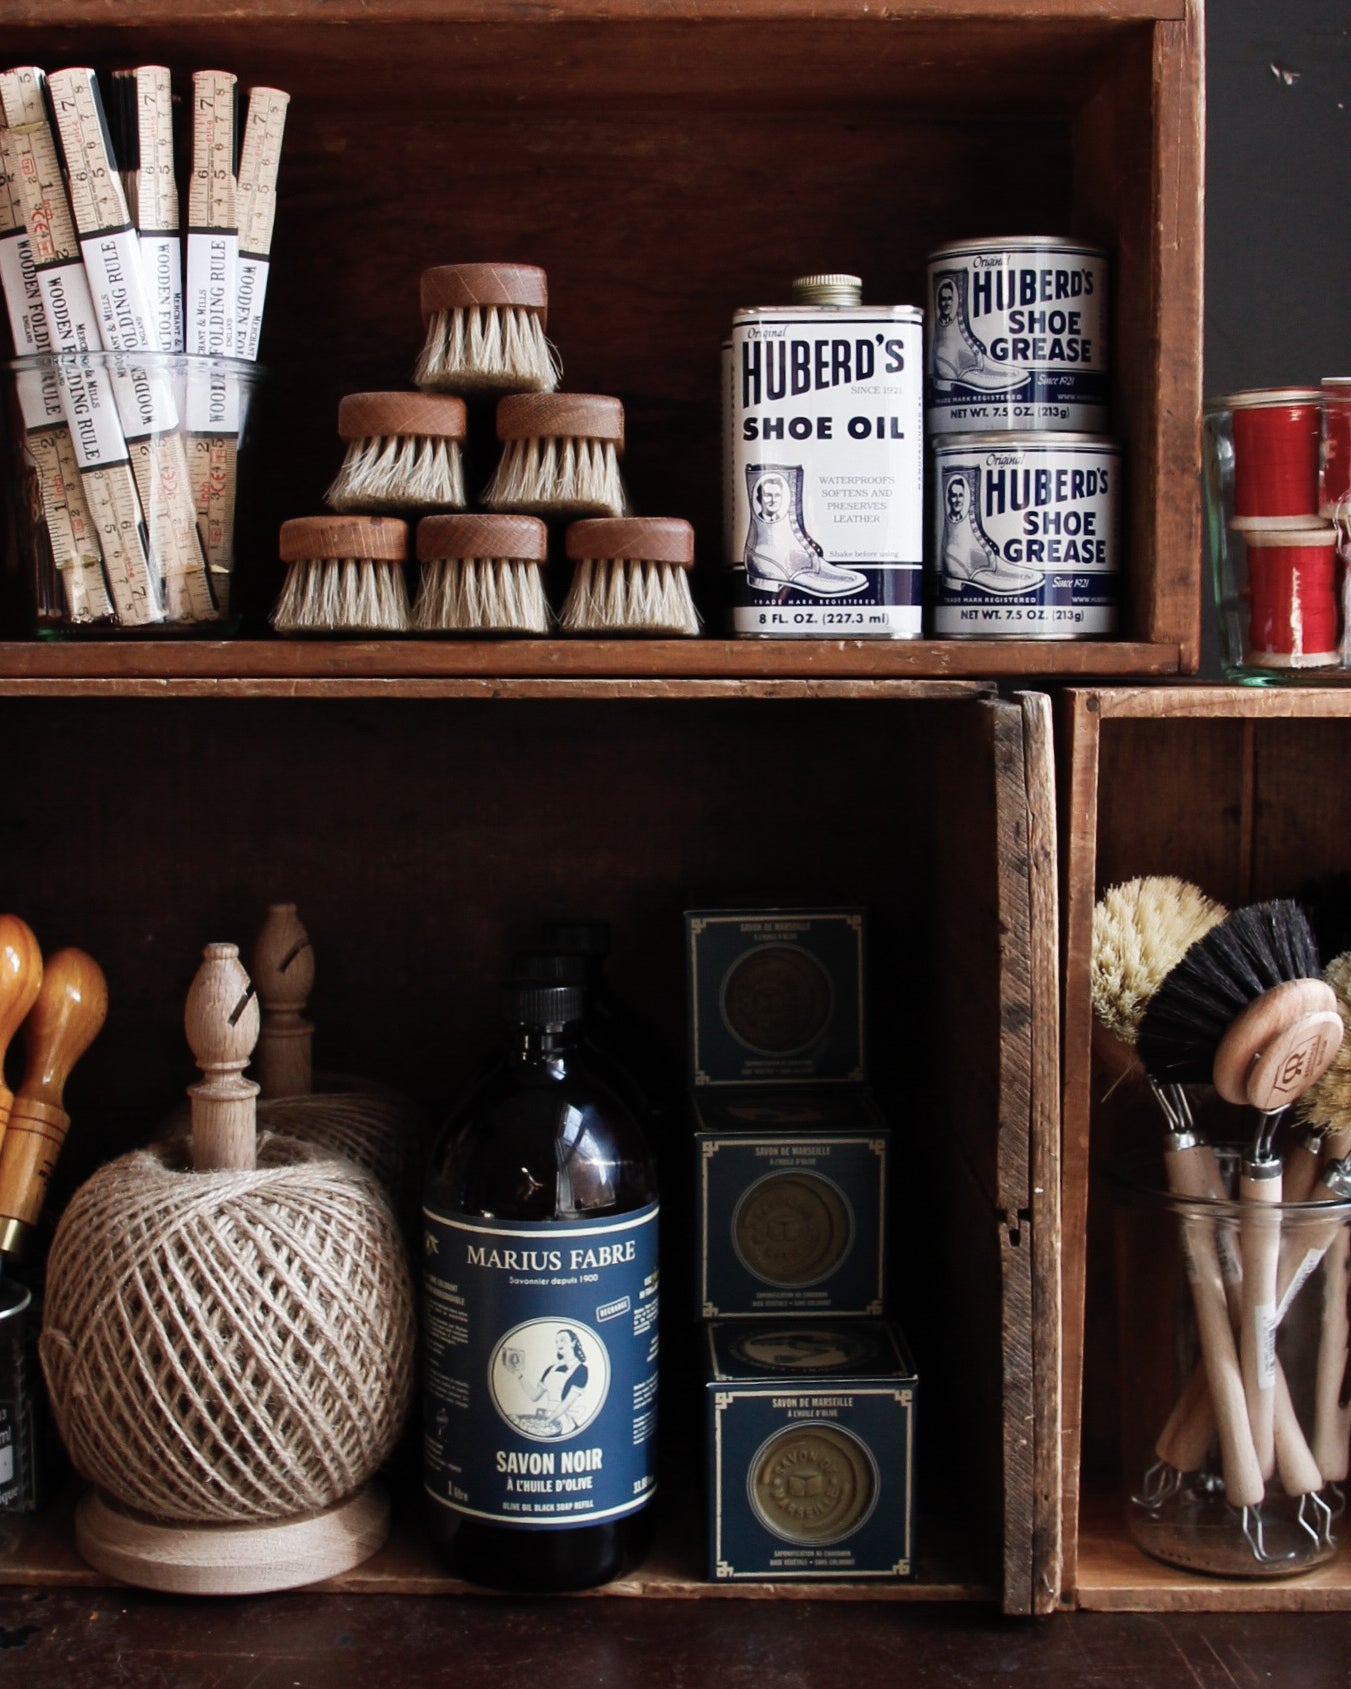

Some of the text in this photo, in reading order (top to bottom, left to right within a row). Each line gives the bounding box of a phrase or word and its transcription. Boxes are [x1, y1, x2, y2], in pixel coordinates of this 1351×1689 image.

[144, 95, 155, 106] 7
[200, 99, 214, 111] 7
[215, 115, 224, 123] 7
[61, 100, 88, 181] 7 6
[215, 143, 224, 151] 6
[87, 141, 96, 149] 6
[93, 167, 105, 178] 5
[242, 114, 267, 191] 7 6
[159, 165, 170, 174] 5
[198, 169, 209, 179] 6
[214, 169, 226, 179] 5
[258, 184, 270, 194] 5
[41, 181, 69, 259] 1 2
[101, 241, 124, 284] RULE
[973, 255, 1010, 269] Original
[157, 244, 171, 305] WOODEN
[209, 240, 226, 356] RULE FOLDING
[237, 266, 256, 324] WOODEN
[973, 269, 1093, 318] HUBERD'S
[101, 294, 116, 332] MILLS &
[174, 293, 182, 335] MERCHANT
[197, 289, 206, 327] MILLS &
[17, 240, 62, 416] WOODEN RULE
[1008, 310, 1081, 335] SHOE
[747, 325, 789, 341] Original
[990, 338, 1092, 362] GREASE
[48, 277, 101, 461] WOODEN RULE
[742, 333, 905, 409] HUBERD'S
[1037, 374, 1075, 385] Since 1921
[84, 369, 100, 409] & MILLS
[851, 386, 902, 395] SINCE 1921
[973, 394, 1022, 402] REGISTERED
[951, 407, 1070, 419] NET WT. 7.5 OZ. (213g)
[743, 416, 905, 441] SHOE OIL
[140, 445, 150, 456] 2
[197, 442, 209, 452] 2
[212, 439, 225, 448] 5
[986, 454, 1025, 468] Original
[40, 437, 55, 448] 2
[54, 503, 66, 511] 1
[54, 430, 67, 440] 5
[65, 483, 75, 491] 3
[70, 509, 80, 517] 2
[819, 476, 895, 485] WATERPROOFS
[821, 489, 893, 498] SOFTENS AND
[986, 467, 1108, 518] HUBERD'S
[827, 502, 887, 511] PRESERVES
[211, 518, 220, 526] 2
[833, 515, 880, 524] LEATHER
[1023, 511, 1096, 536] SHOE
[104, 523, 116, 533] 5
[113, 550, 122, 558] 6
[121, 520, 146, 597] 6 7
[880, 551, 899, 560] using
[1004, 539, 1106, 564] GREASE
[1052, 577, 1090, 588] Since 1921
[759, 613, 889, 625] 8 FL. OZ. (227.3 ml)
[961, 609, 1084, 622] NET WT. 7.5 OZ. (213g)
[466, 1240, 636, 1271] MARIUS FABRE
[509, 1273, 598, 1286] Savonnier depuis 1900
[772, 1397, 853, 1408] SAVON DE MARSEILLE
[496, 1447, 603, 1475] SAVON NOIR
[448, 1480, 453, 1496] 1
[506, 1475, 593, 1493] À L'HUILE D'OLIVE
[502, 1500, 594, 1512] OLIVE OIL BLACK SOAP REFILL
